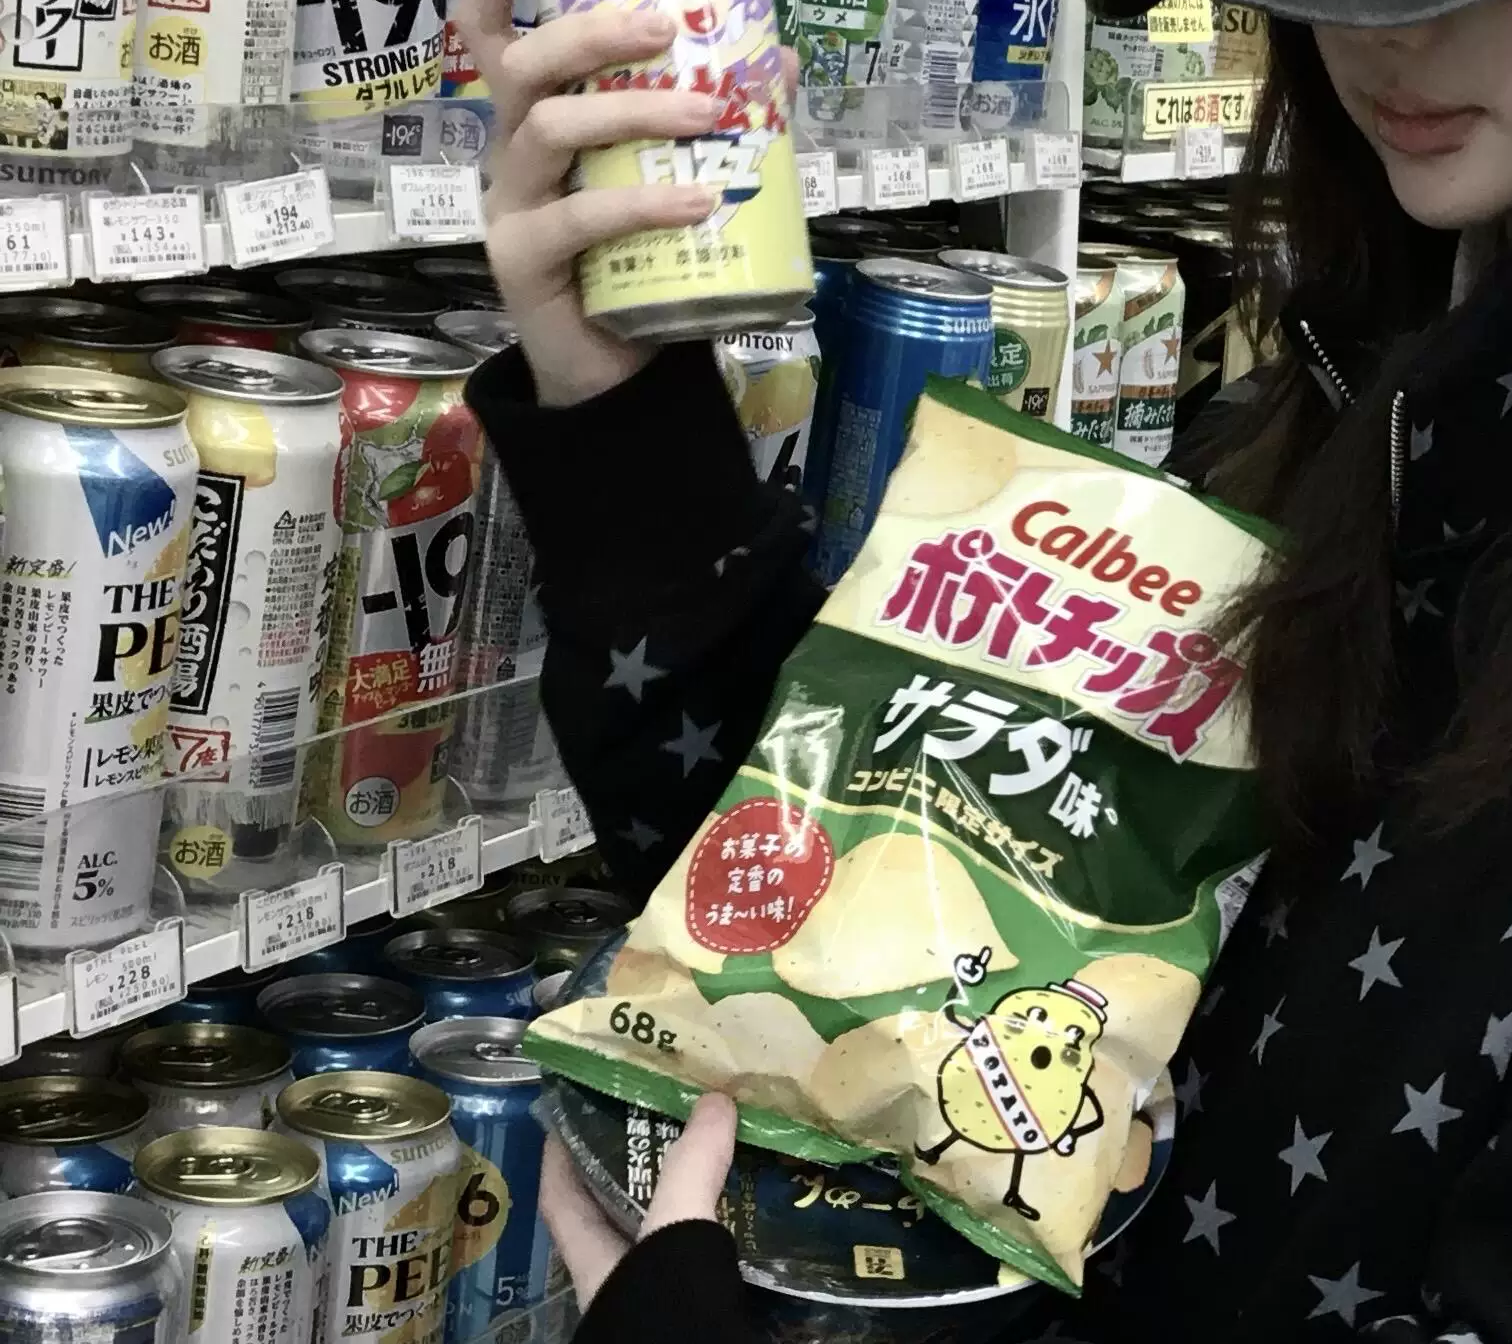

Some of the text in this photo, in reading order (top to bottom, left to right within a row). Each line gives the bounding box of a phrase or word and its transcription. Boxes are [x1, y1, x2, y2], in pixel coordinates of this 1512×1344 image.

[813, 7, 848, 26] ウメ
[149, 29, 201, 67] お酒
[322, 43, 419, 89] STRONG
[266, 205, 298, 226] ¥194
[107, 499, 176, 557] New!
[1011, 499, 1202, 617] Calbee
[104, 574, 175, 614] THE
[881, 529, 1247, 756] ポテトチップス
[873, 674, 1103, 838] サラダ味
[352, 788, 396, 816] お酒
[848, 768, 1065, 879] コンビニ限定サイズ
[77, 851, 119, 869] ALC.
[175, 836, 225, 869] お酒
[720, 833, 807, 862] お菓子の
[72, 869, 115, 901] 5%
[727, 863, 784, 896] 定番の
[277, 906, 315, 931] ¥218
[109, 965, 151, 992] ¥228
[610, 1000, 679, 1053] 68g
[970, 1029, 1041, 1146] POTATO
[339, 1172, 400, 1215] New!
[457, 1172, 501, 1228] 6
[353, 1231, 418, 1258] THE
